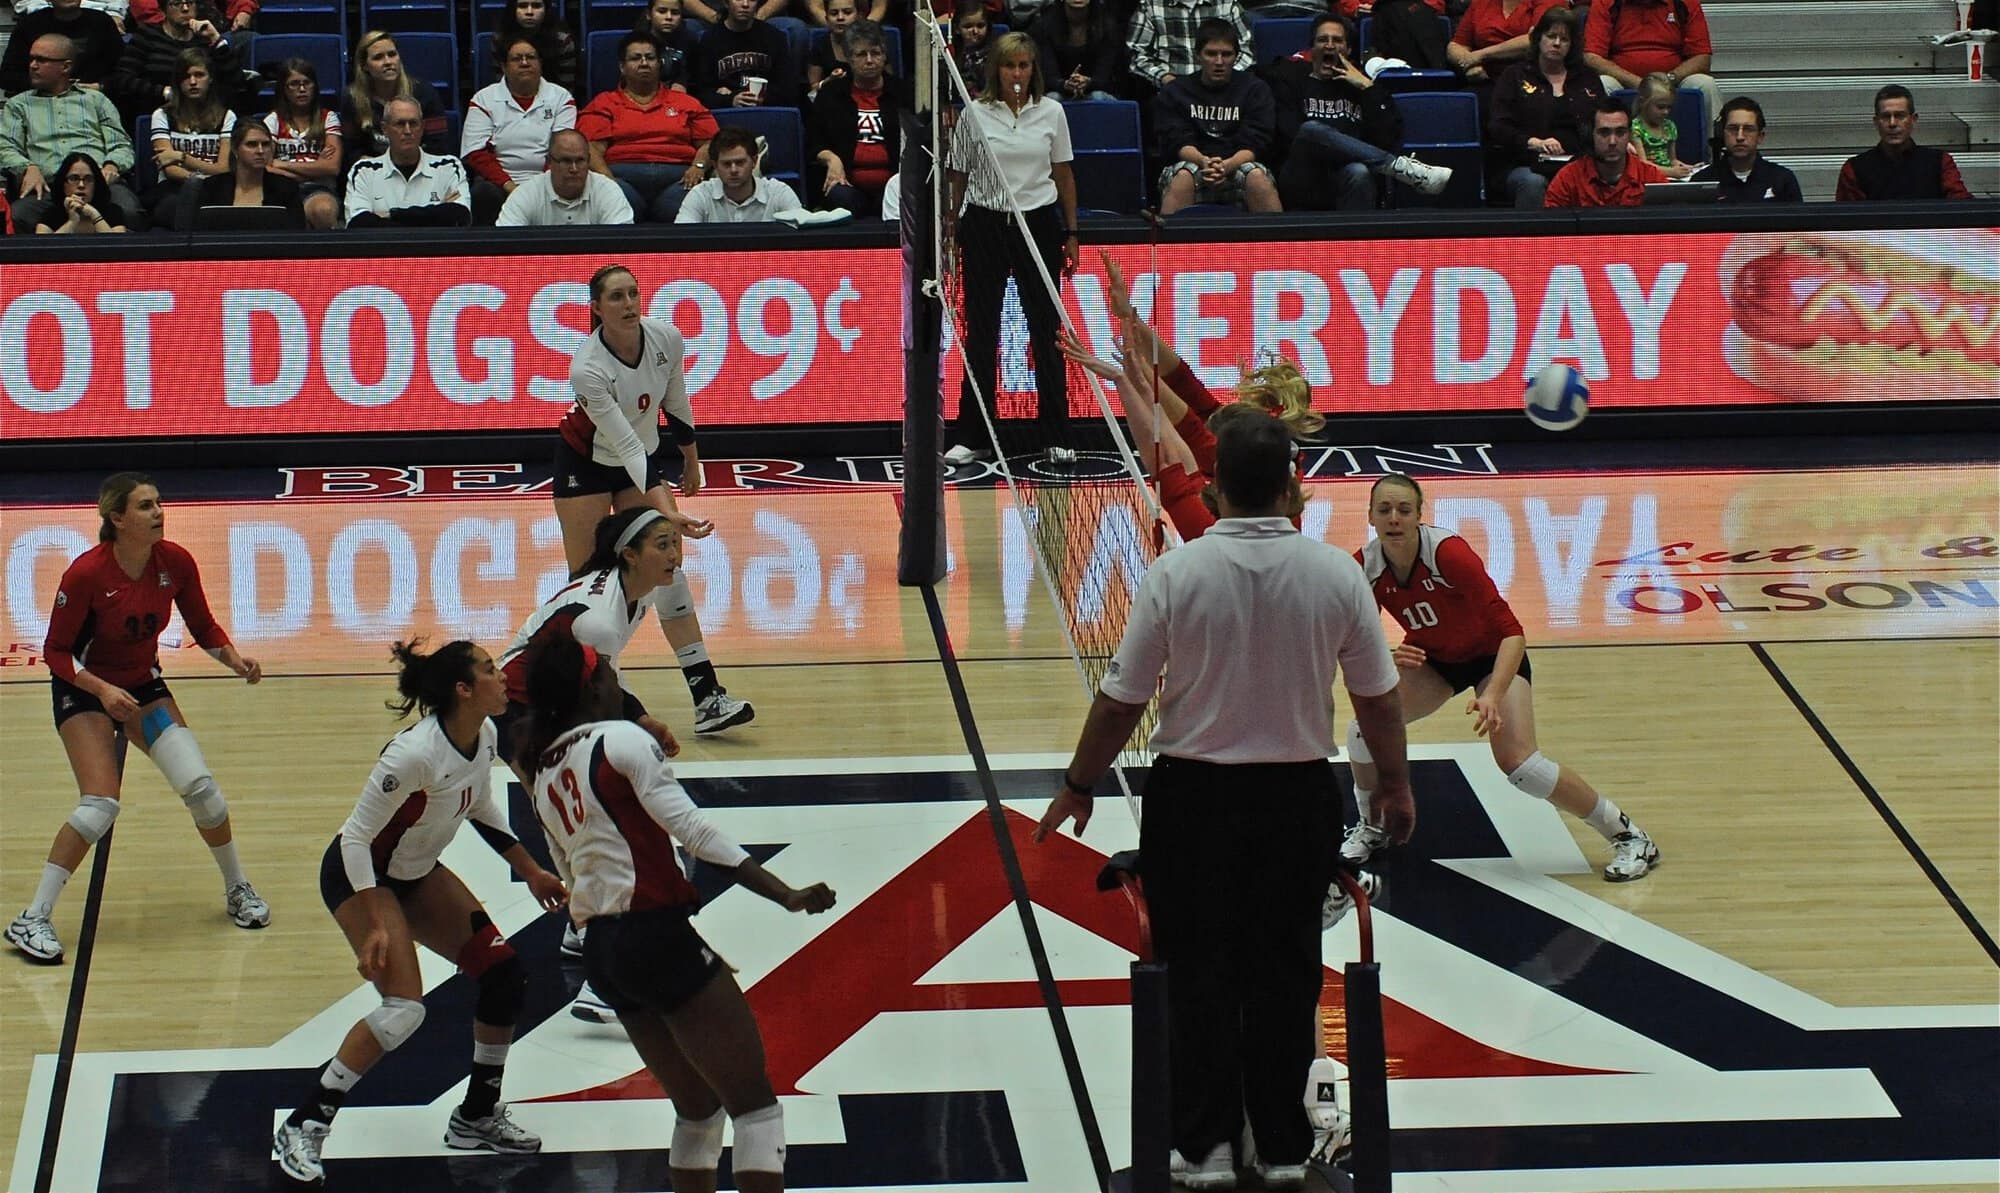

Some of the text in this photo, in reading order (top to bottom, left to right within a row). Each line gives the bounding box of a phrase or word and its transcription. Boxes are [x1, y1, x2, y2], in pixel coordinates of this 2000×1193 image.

[1190, 103, 1240, 121] ARIZONA
[221, 282, 592, 409] DOGS
[637, 392, 652, 415] 9
[276, 443, 1499, 499] BER DON
[1594, 541, 1867, 567] Lute
[1615, 579, 2000, 615] OLSON
[1401, 601, 1439, 630] 10
[453, 785, 473, 819] 11
[546, 767, 586, 836] 13
